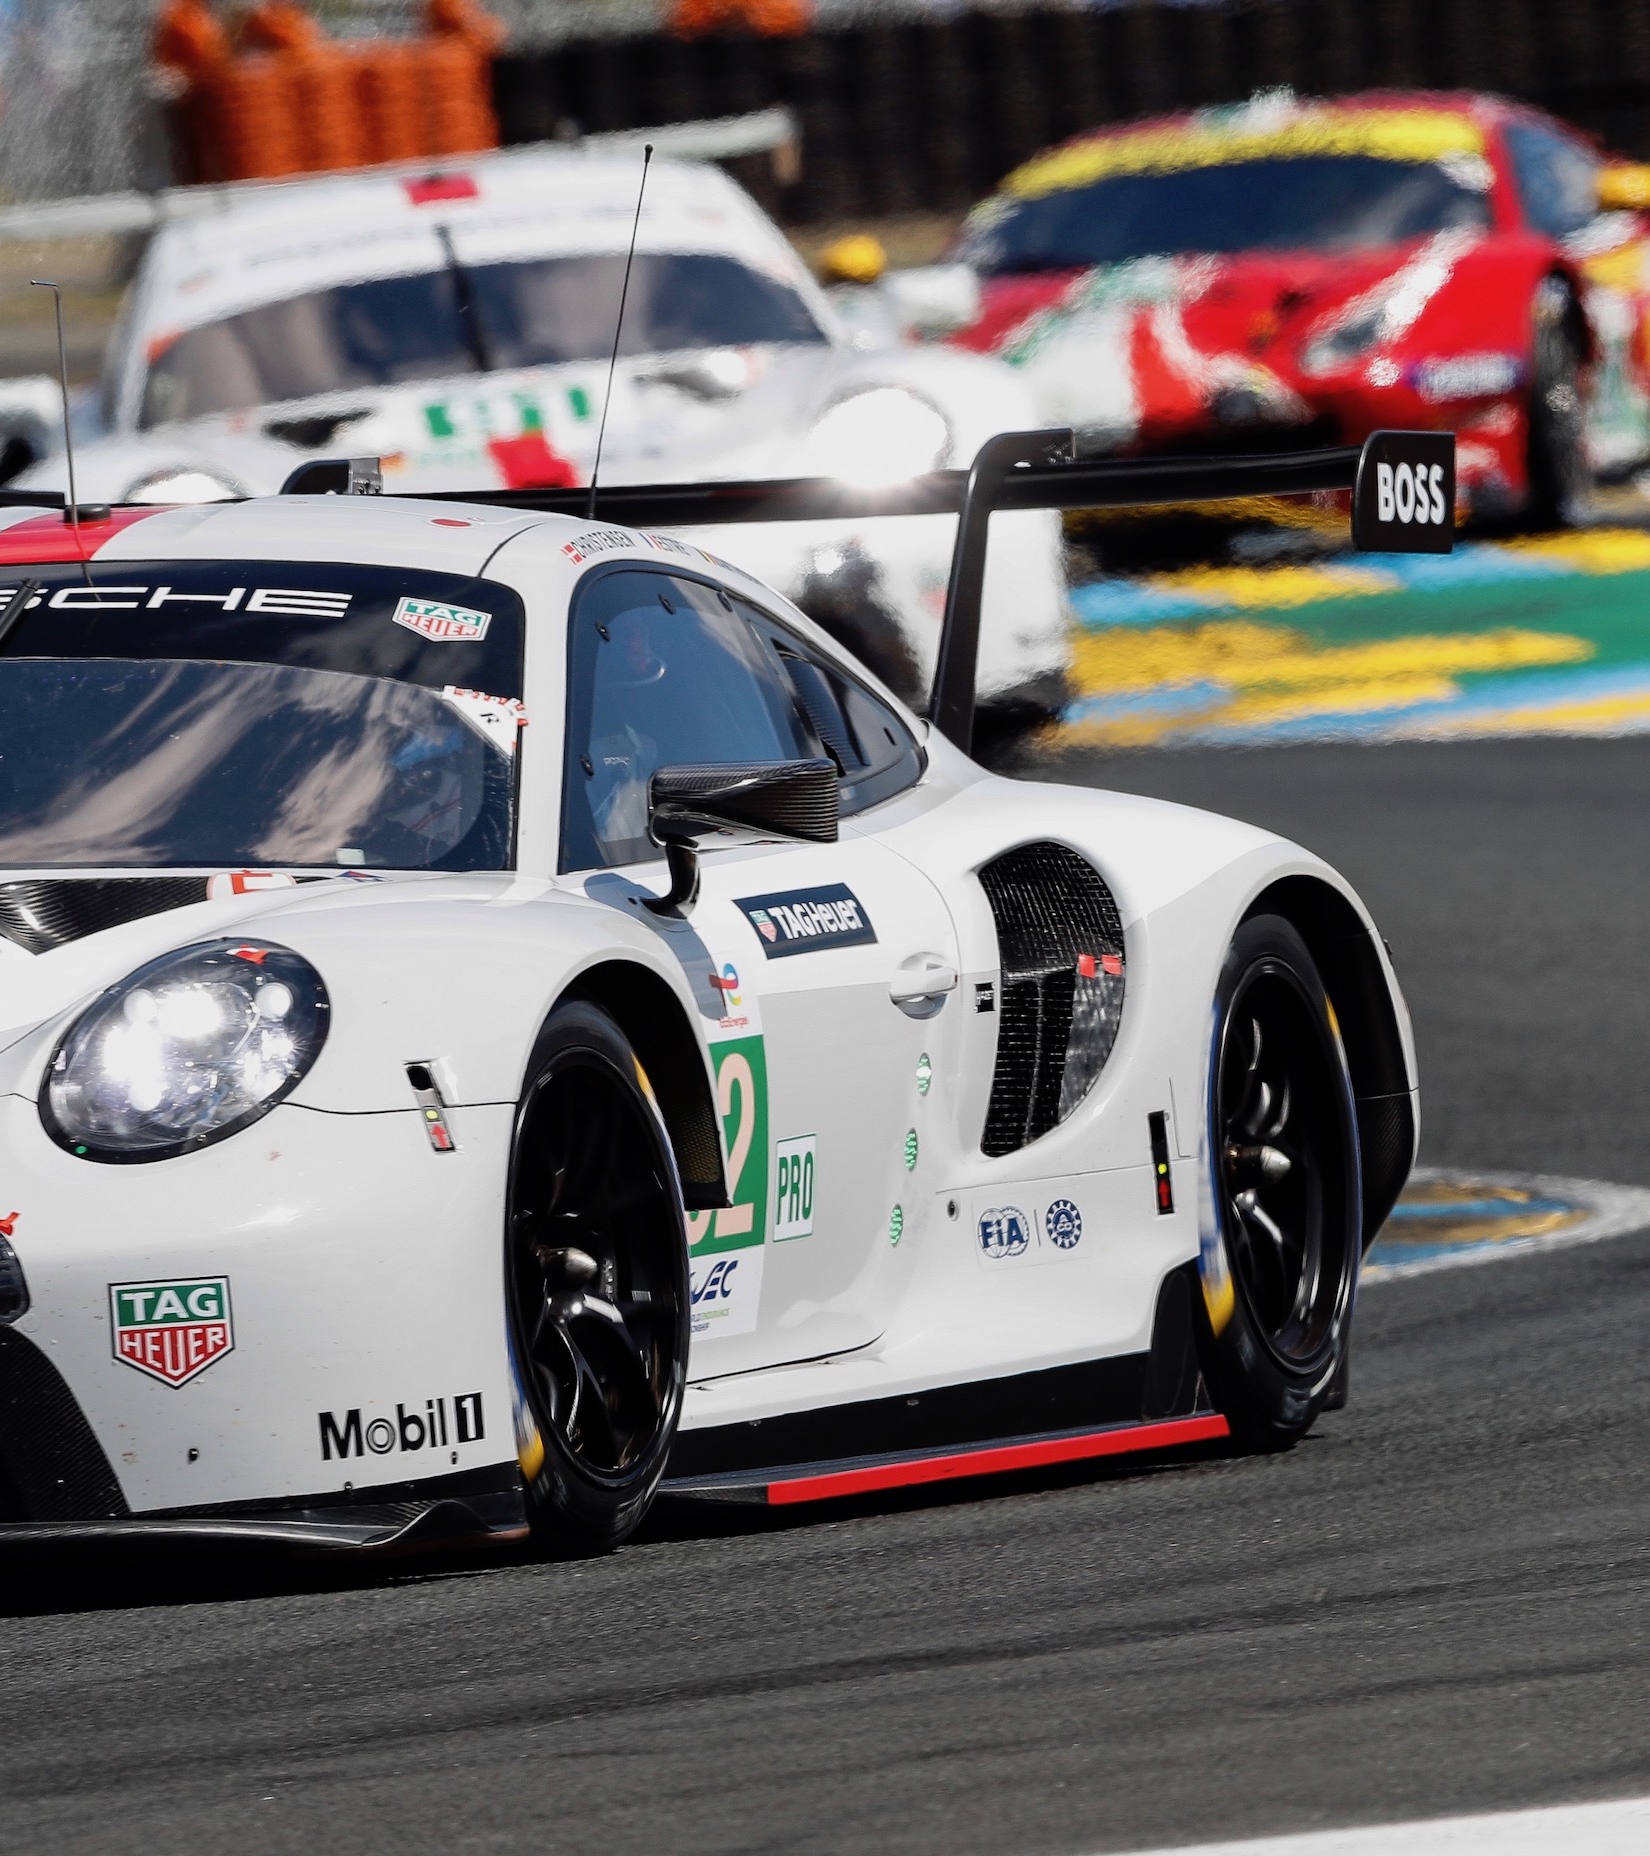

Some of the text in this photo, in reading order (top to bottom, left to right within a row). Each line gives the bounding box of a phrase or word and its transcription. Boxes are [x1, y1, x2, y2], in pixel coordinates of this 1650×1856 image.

[1377, 462, 1447, 525] BOSS
[570, 530, 636, 559] CHRISTENSEN
[402, 613, 479, 636] HEUER
[408, 602, 480, 627] TAG
[776, 1151, 814, 1225] PRO
[121, 1286, 220, 1323] TAG
[121, 1325, 225, 1377] HEUER
[318, 1396, 476, 1461] Mobil 1
